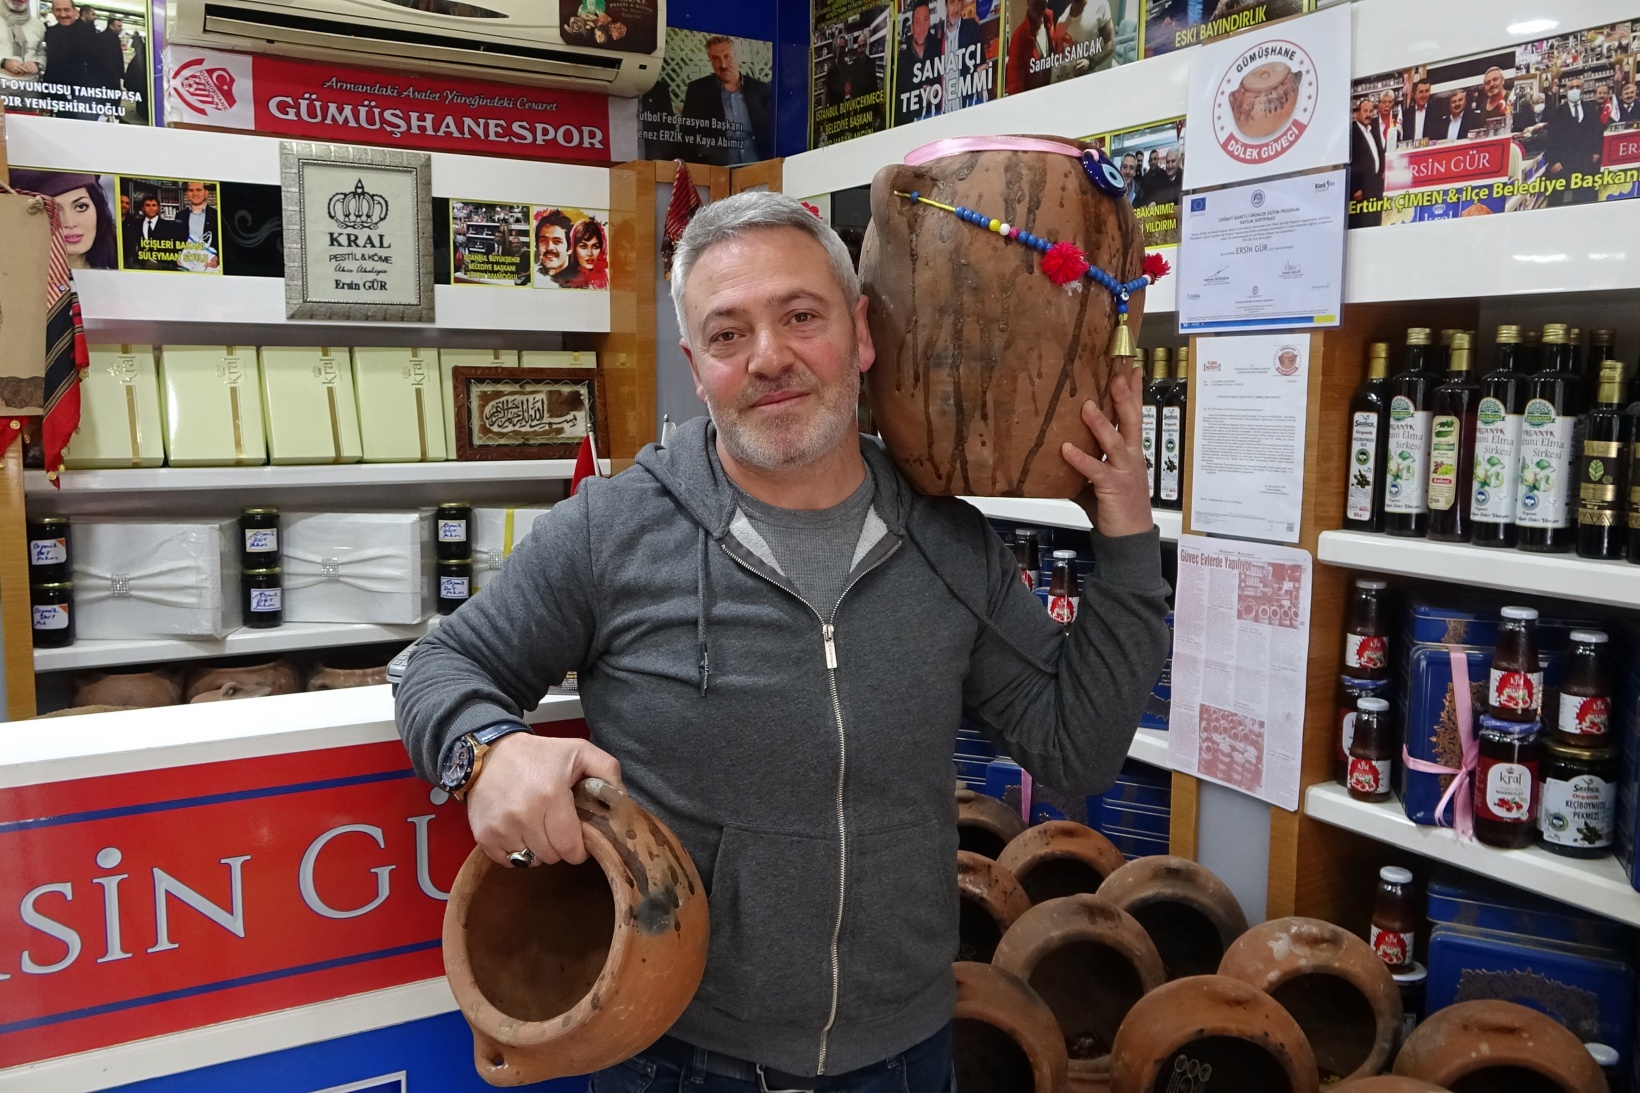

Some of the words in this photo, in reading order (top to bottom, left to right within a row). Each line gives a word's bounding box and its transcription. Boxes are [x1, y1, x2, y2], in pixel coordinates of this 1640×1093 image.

[1175, 26, 1197, 48] ESKİ
[1200, 6, 1267, 38] BAYINDIRLIK
[913, 43, 981, 84] SANATÇI
[1029, 51, 1062, 74] Sanatçı
[1065, 37, 1103, 63] SANCAK
[1236, 46, 1297, 73] GÜMÜŞHANE
[10, 80, 71, 95] OYUNCUSU
[73, 85, 142, 103] TAHSİNPAŞA
[323, 76, 399, 98] Armandaki
[401, 86, 440, 102] Asalet
[443, 90, 514, 108] Yüreğindeki
[516, 97, 558, 111] Cesaret
[901, 83, 942, 113] TEYO
[948, 62, 993, 100] EMMİ
[24, 97, 126, 116] YENİŞEHİRLİOĞLU
[268, 93, 604, 150] GÜMÜŞHANESPOR
[639, 111, 661, 121] utbol
[662, 112, 710, 129] Federasyon
[711, 118, 743, 131] Başkanı
[638, 130, 658, 140] enez
[660, 130, 683, 142] ERZİK
[684, 134, 696, 144] ve
[696, 134, 716, 148] Kaya
[718, 136, 744, 149] Abimiz
[1228, 140, 1259, 160] DÖLEK
[1261, 124, 1299, 158] GÜVECİ
[1451, 150, 1490, 172] GÜR
[1348, 195, 1392, 215] Ertürk
[1395, 190, 1443, 213] ÇİMEN
[1447, 188, 1458, 203] &
[1462, 186, 1489, 204] ilçe
[1493, 176, 1566, 199] Belediye
[1146, 218, 1176, 232] YILDIRIM
[328, 232, 392, 248] KRAL
[1236, 244, 1253, 254] ERSİN
[1254, 243, 1268, 252] GÜR
[329, 251, 360, 262] PESTİL
[360, 253, 367, 262] &
[368, 252, 393, 264] KÖME
[334, 279, 360, 290] Ersin
[363, 278, 388, 290] GÜR
[319, 358, 337, 384] kral
[409, 360, 426, 386] kral
[1396, 440, 1421, 451] Sirkesi
[1402, 431, 1424, 441] Elma
[1492, 434, 1514, 446] Elma
[1541, 438, 1564, 449] Elma
[1484, 446, 1512, 456] Sirkesi
[1533, 448, 1562, 460] Sirkesi
[1180, 548, 1200, 566] Güveç
[1200, 553, 1222, 568] Evlerde
[1224, 556, 1252, 572] Yapılıyor
[1500, 772, 1522, 786] kral
[1566, 799, 1606, 810] KEÇİBOYNUZU
[1573, 810, 1600, 821] PEKMEZİ
[0, 847, 250, 981] SİN
